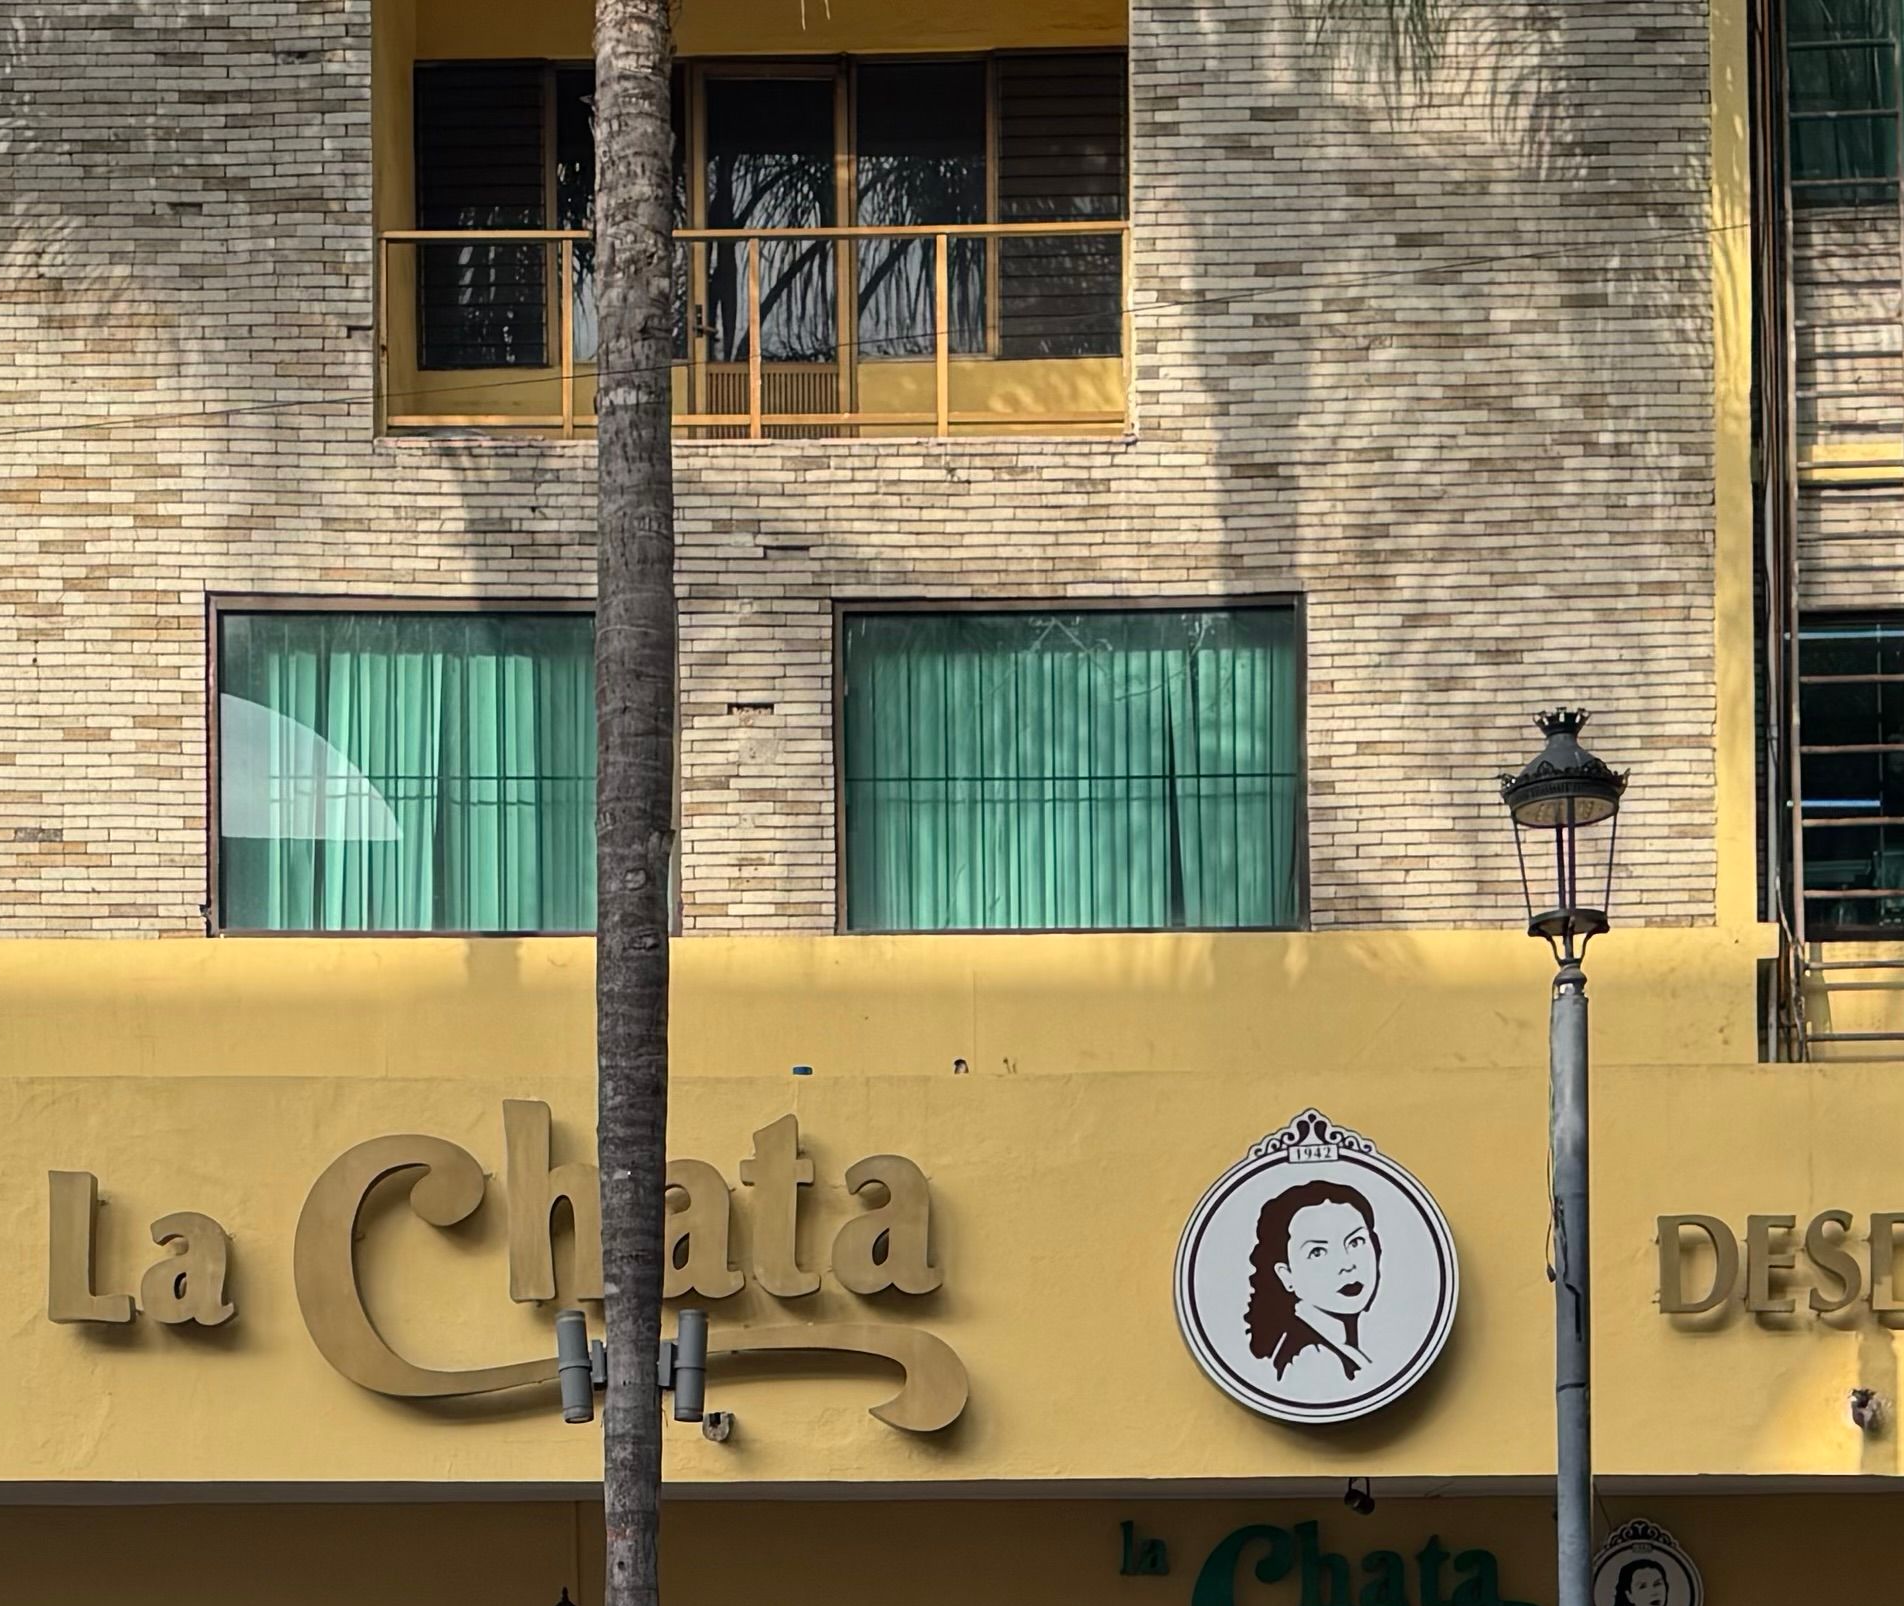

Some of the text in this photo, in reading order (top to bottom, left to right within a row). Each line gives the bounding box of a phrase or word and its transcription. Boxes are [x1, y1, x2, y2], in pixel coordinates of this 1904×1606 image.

[1296, 1146, 1332, 1160] 1942
[47, 1099, 968, 1432] La Chata
[1119, 1519, 1170, 1576] la
